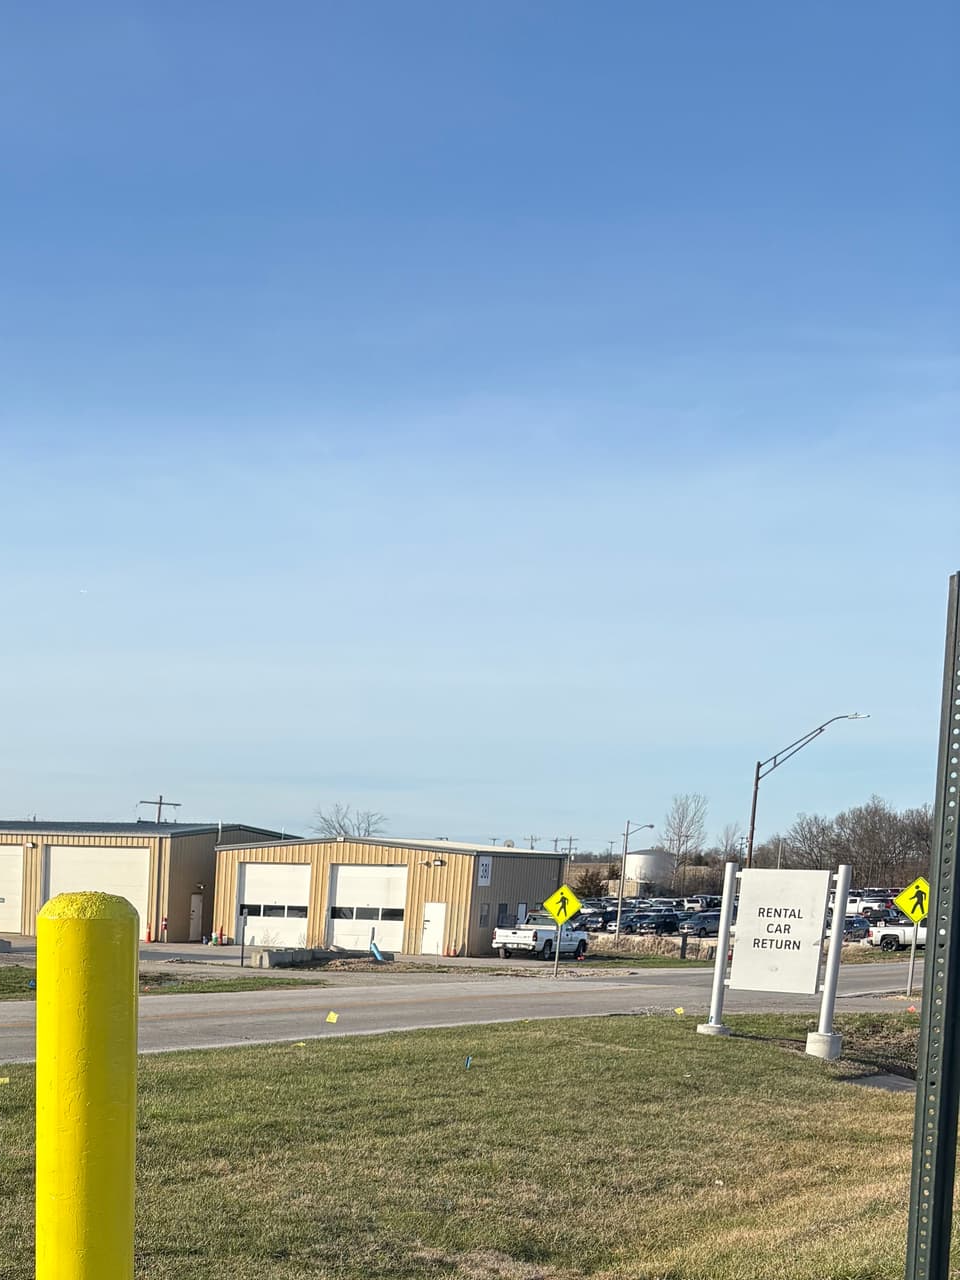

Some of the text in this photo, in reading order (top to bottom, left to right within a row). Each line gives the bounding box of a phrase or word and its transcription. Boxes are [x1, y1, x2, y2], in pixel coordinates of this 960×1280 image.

[758, 907, 804, 919] RENTAL
[766, 923, 791, 934] CAR
[753, 938, 801, 950] RETURN
